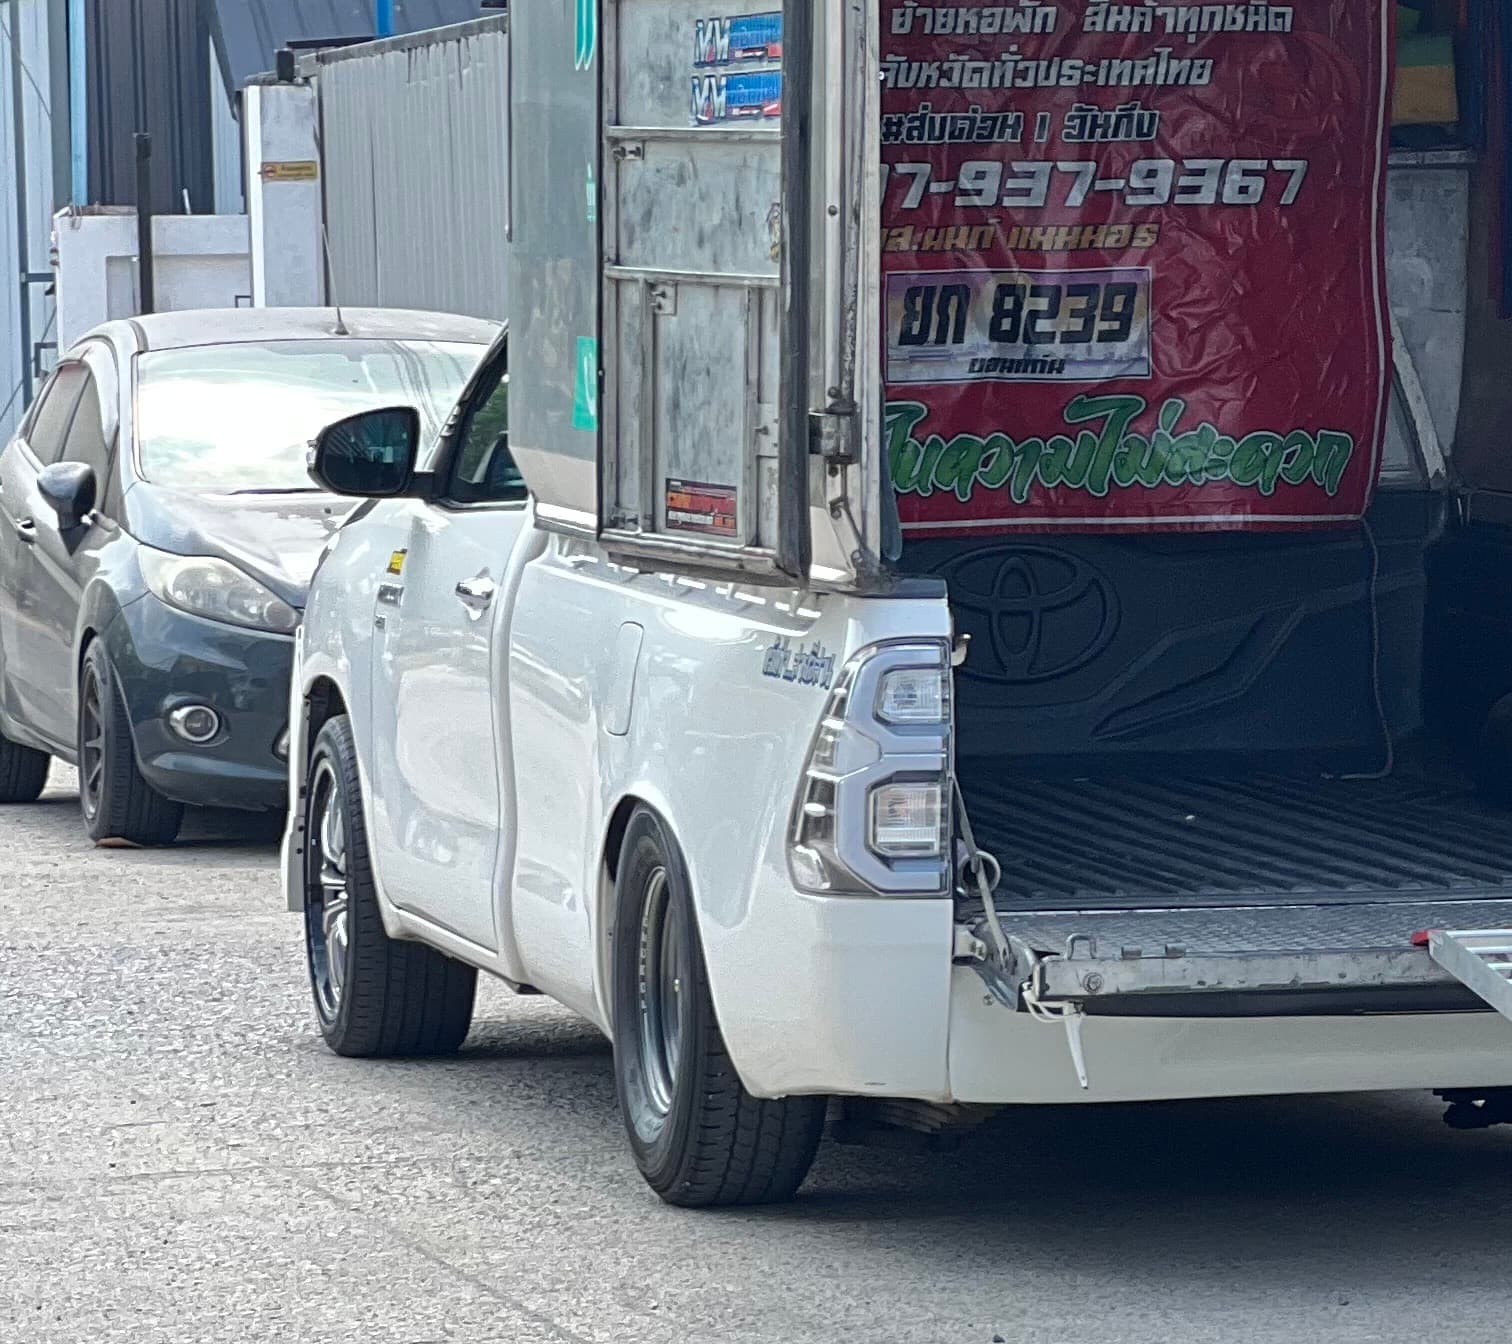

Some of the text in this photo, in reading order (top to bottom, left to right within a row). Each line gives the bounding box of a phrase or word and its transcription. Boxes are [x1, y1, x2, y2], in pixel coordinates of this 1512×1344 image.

[890, 0, 1058, 34] ย้ายหอพัก
[989, 282, 1138, 344] 8239
